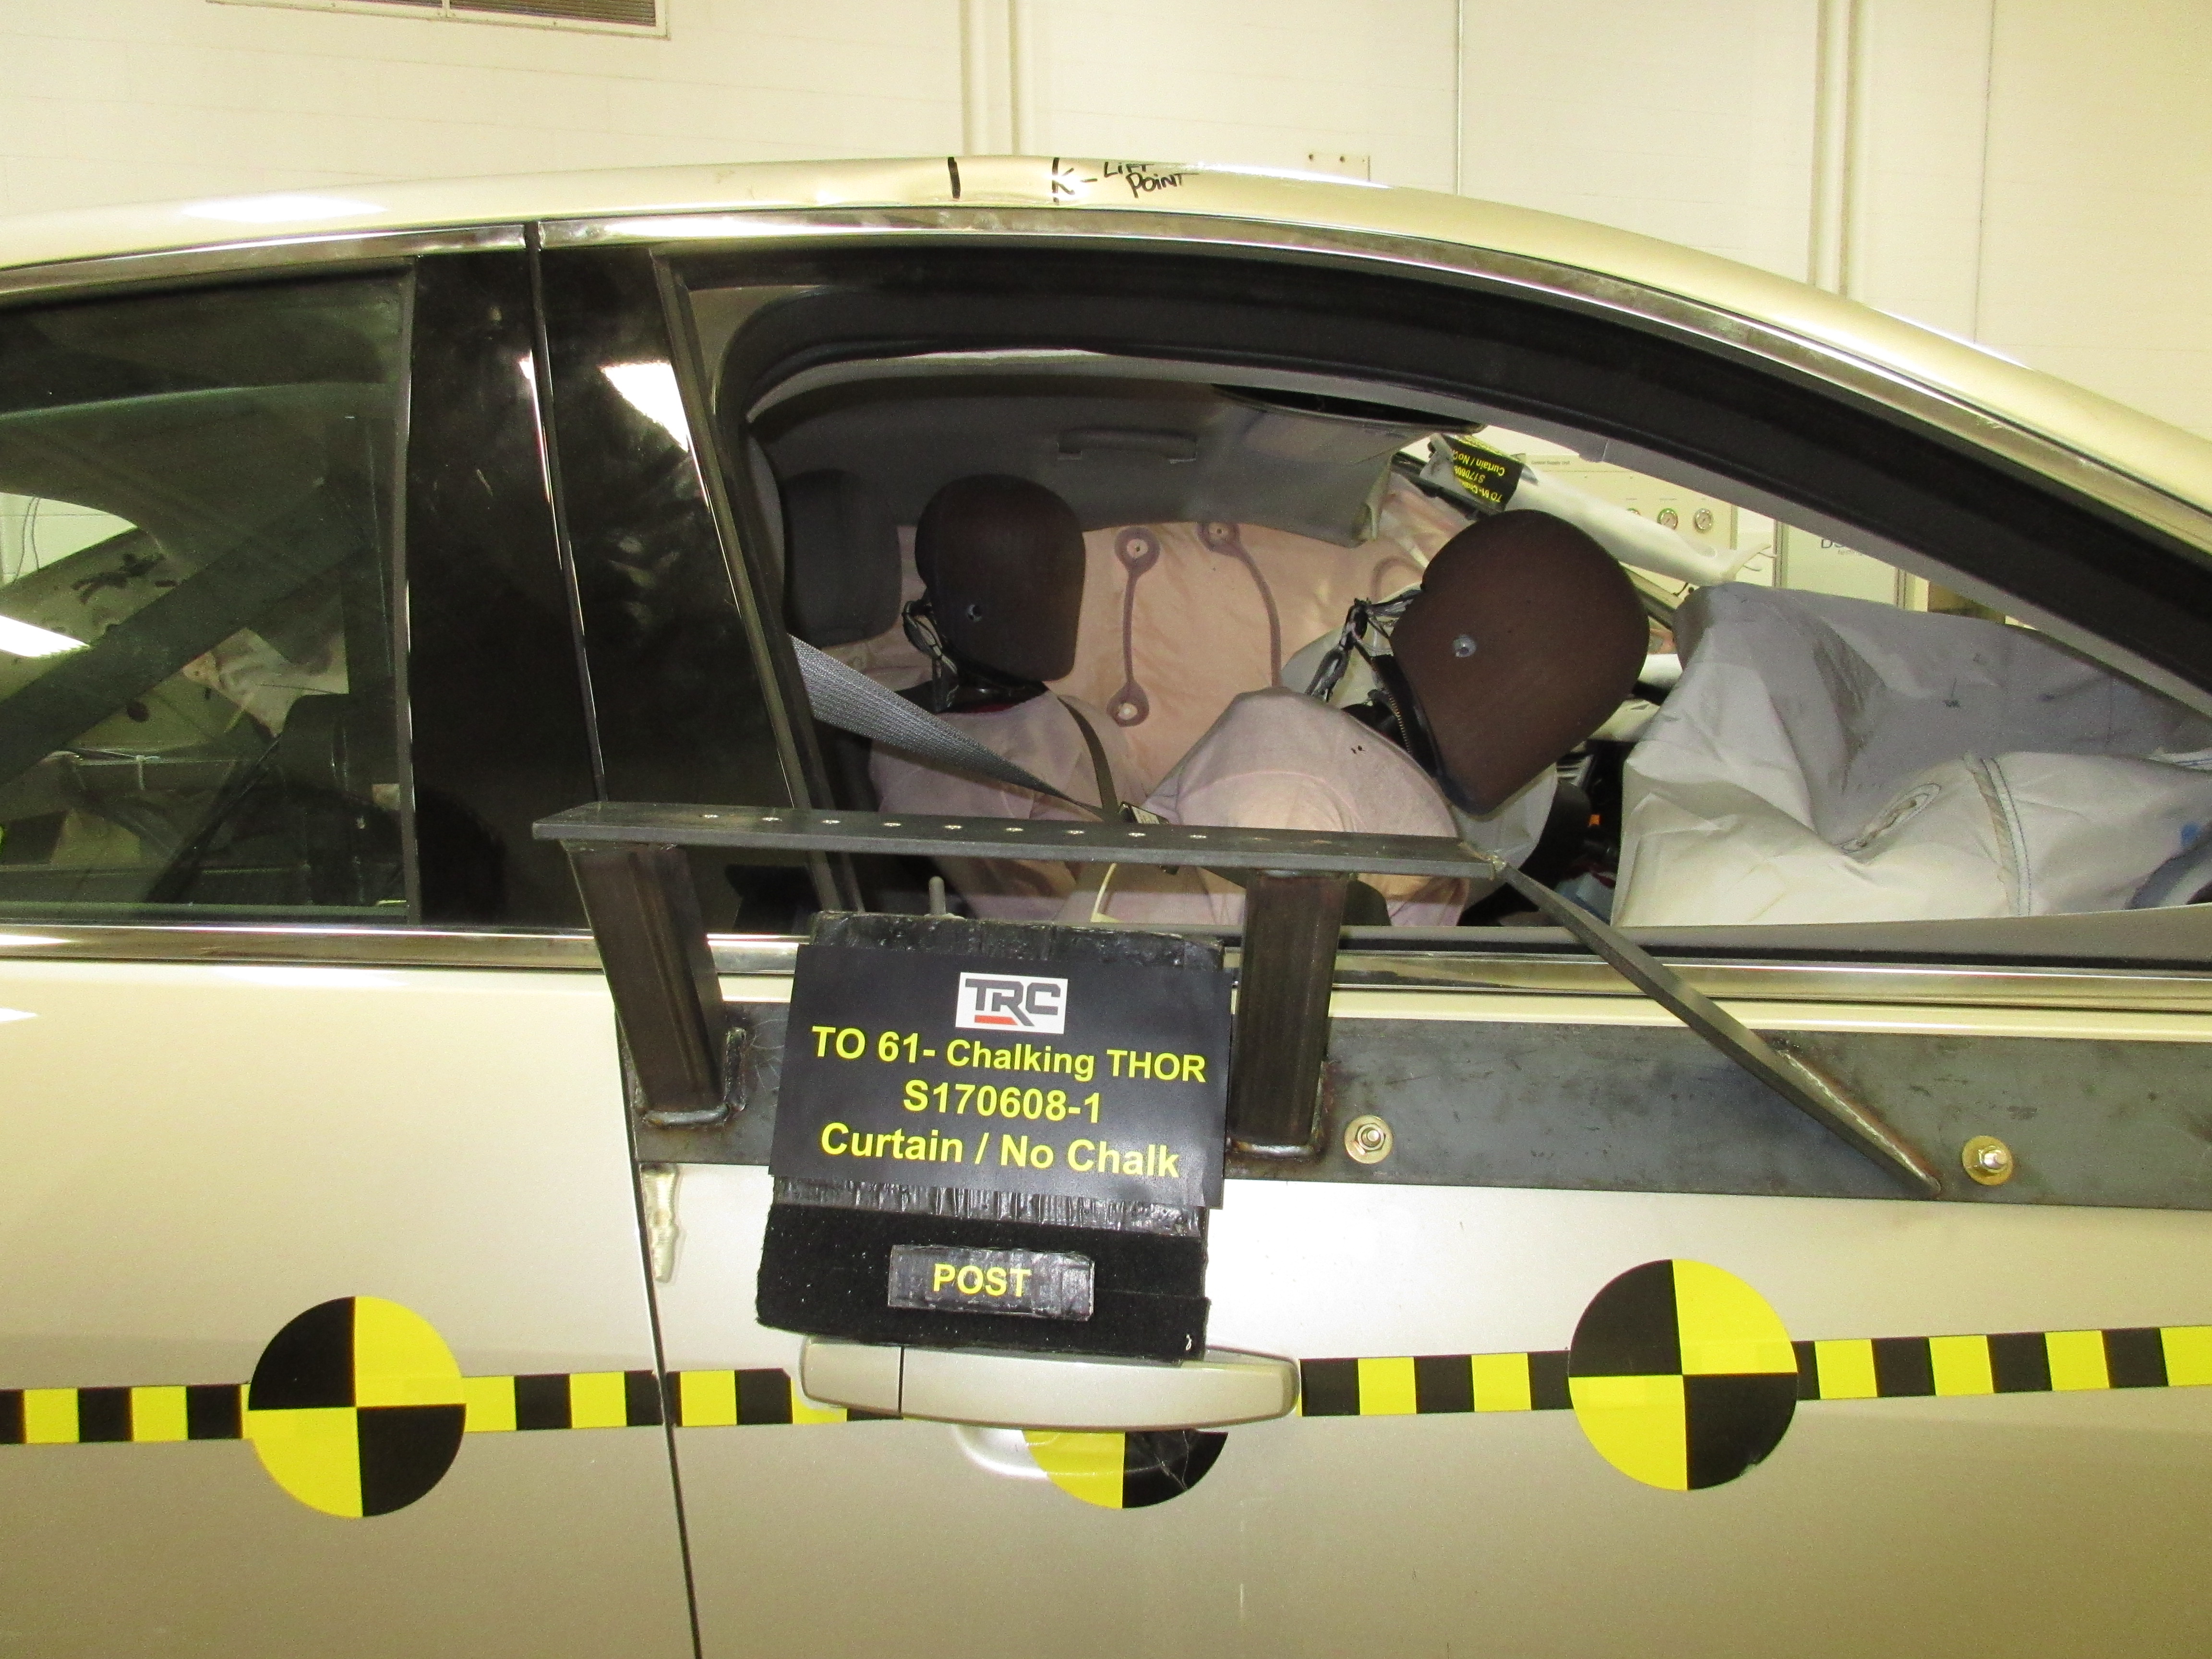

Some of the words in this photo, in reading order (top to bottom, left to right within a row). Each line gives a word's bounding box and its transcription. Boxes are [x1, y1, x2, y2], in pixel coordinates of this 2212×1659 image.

[1476, 458, 1505, 477] Curtain
[965, 978, 1061, 1027] TRC
[812, 1026, 866, 1059] TO
[878, 1031, 936, 1063] 61-
[947, 1039, 1095, 1082] Chalking
[1106, 1049, 1206, 1082] THOR
[903, 1080, 1100, 1123] S170608-1
[821, 1122, 963, 1163] Curtain
[974, 1132, 990, 1164] /
[1000, 1134, 1054, 1168] No
[1068, 1139, 1179, 1178] Chalk
[933, 1263, 1032, 1297] POST
